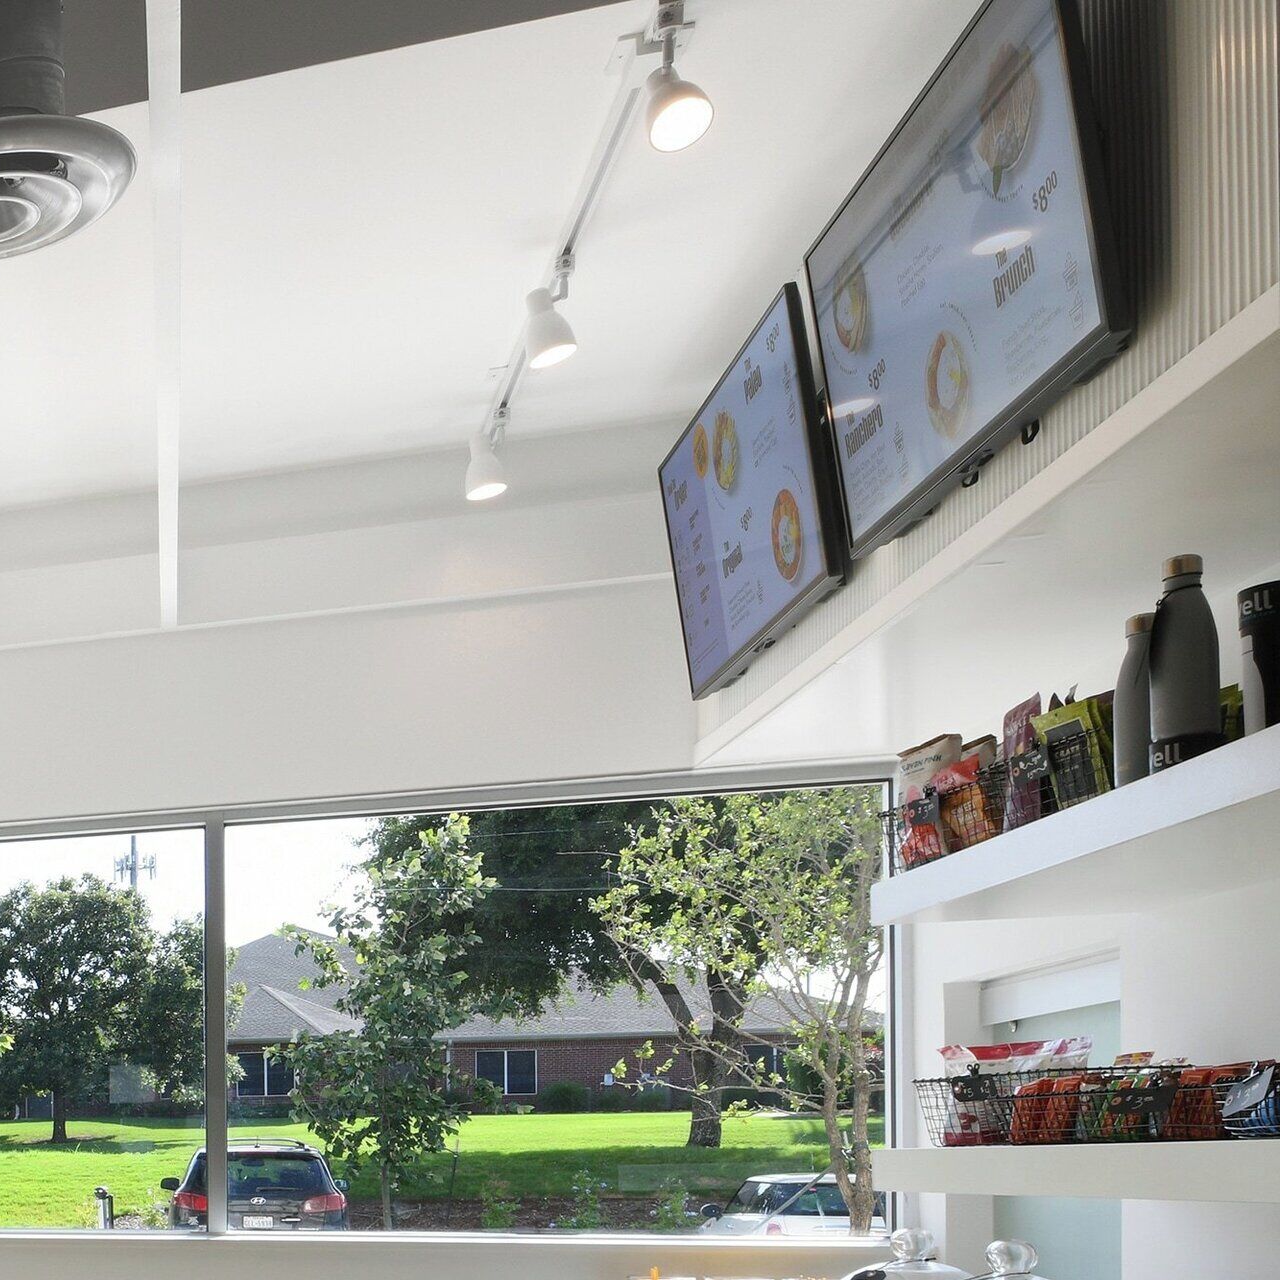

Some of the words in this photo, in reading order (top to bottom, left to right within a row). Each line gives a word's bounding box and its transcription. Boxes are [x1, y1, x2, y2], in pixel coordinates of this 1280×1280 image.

[992, 245, 1036, 310] Brunch
[995, 247, 1008, 271] The
[743, 364, 763, 406] Paleo
[844, 404, 884, 460] Ranchero
